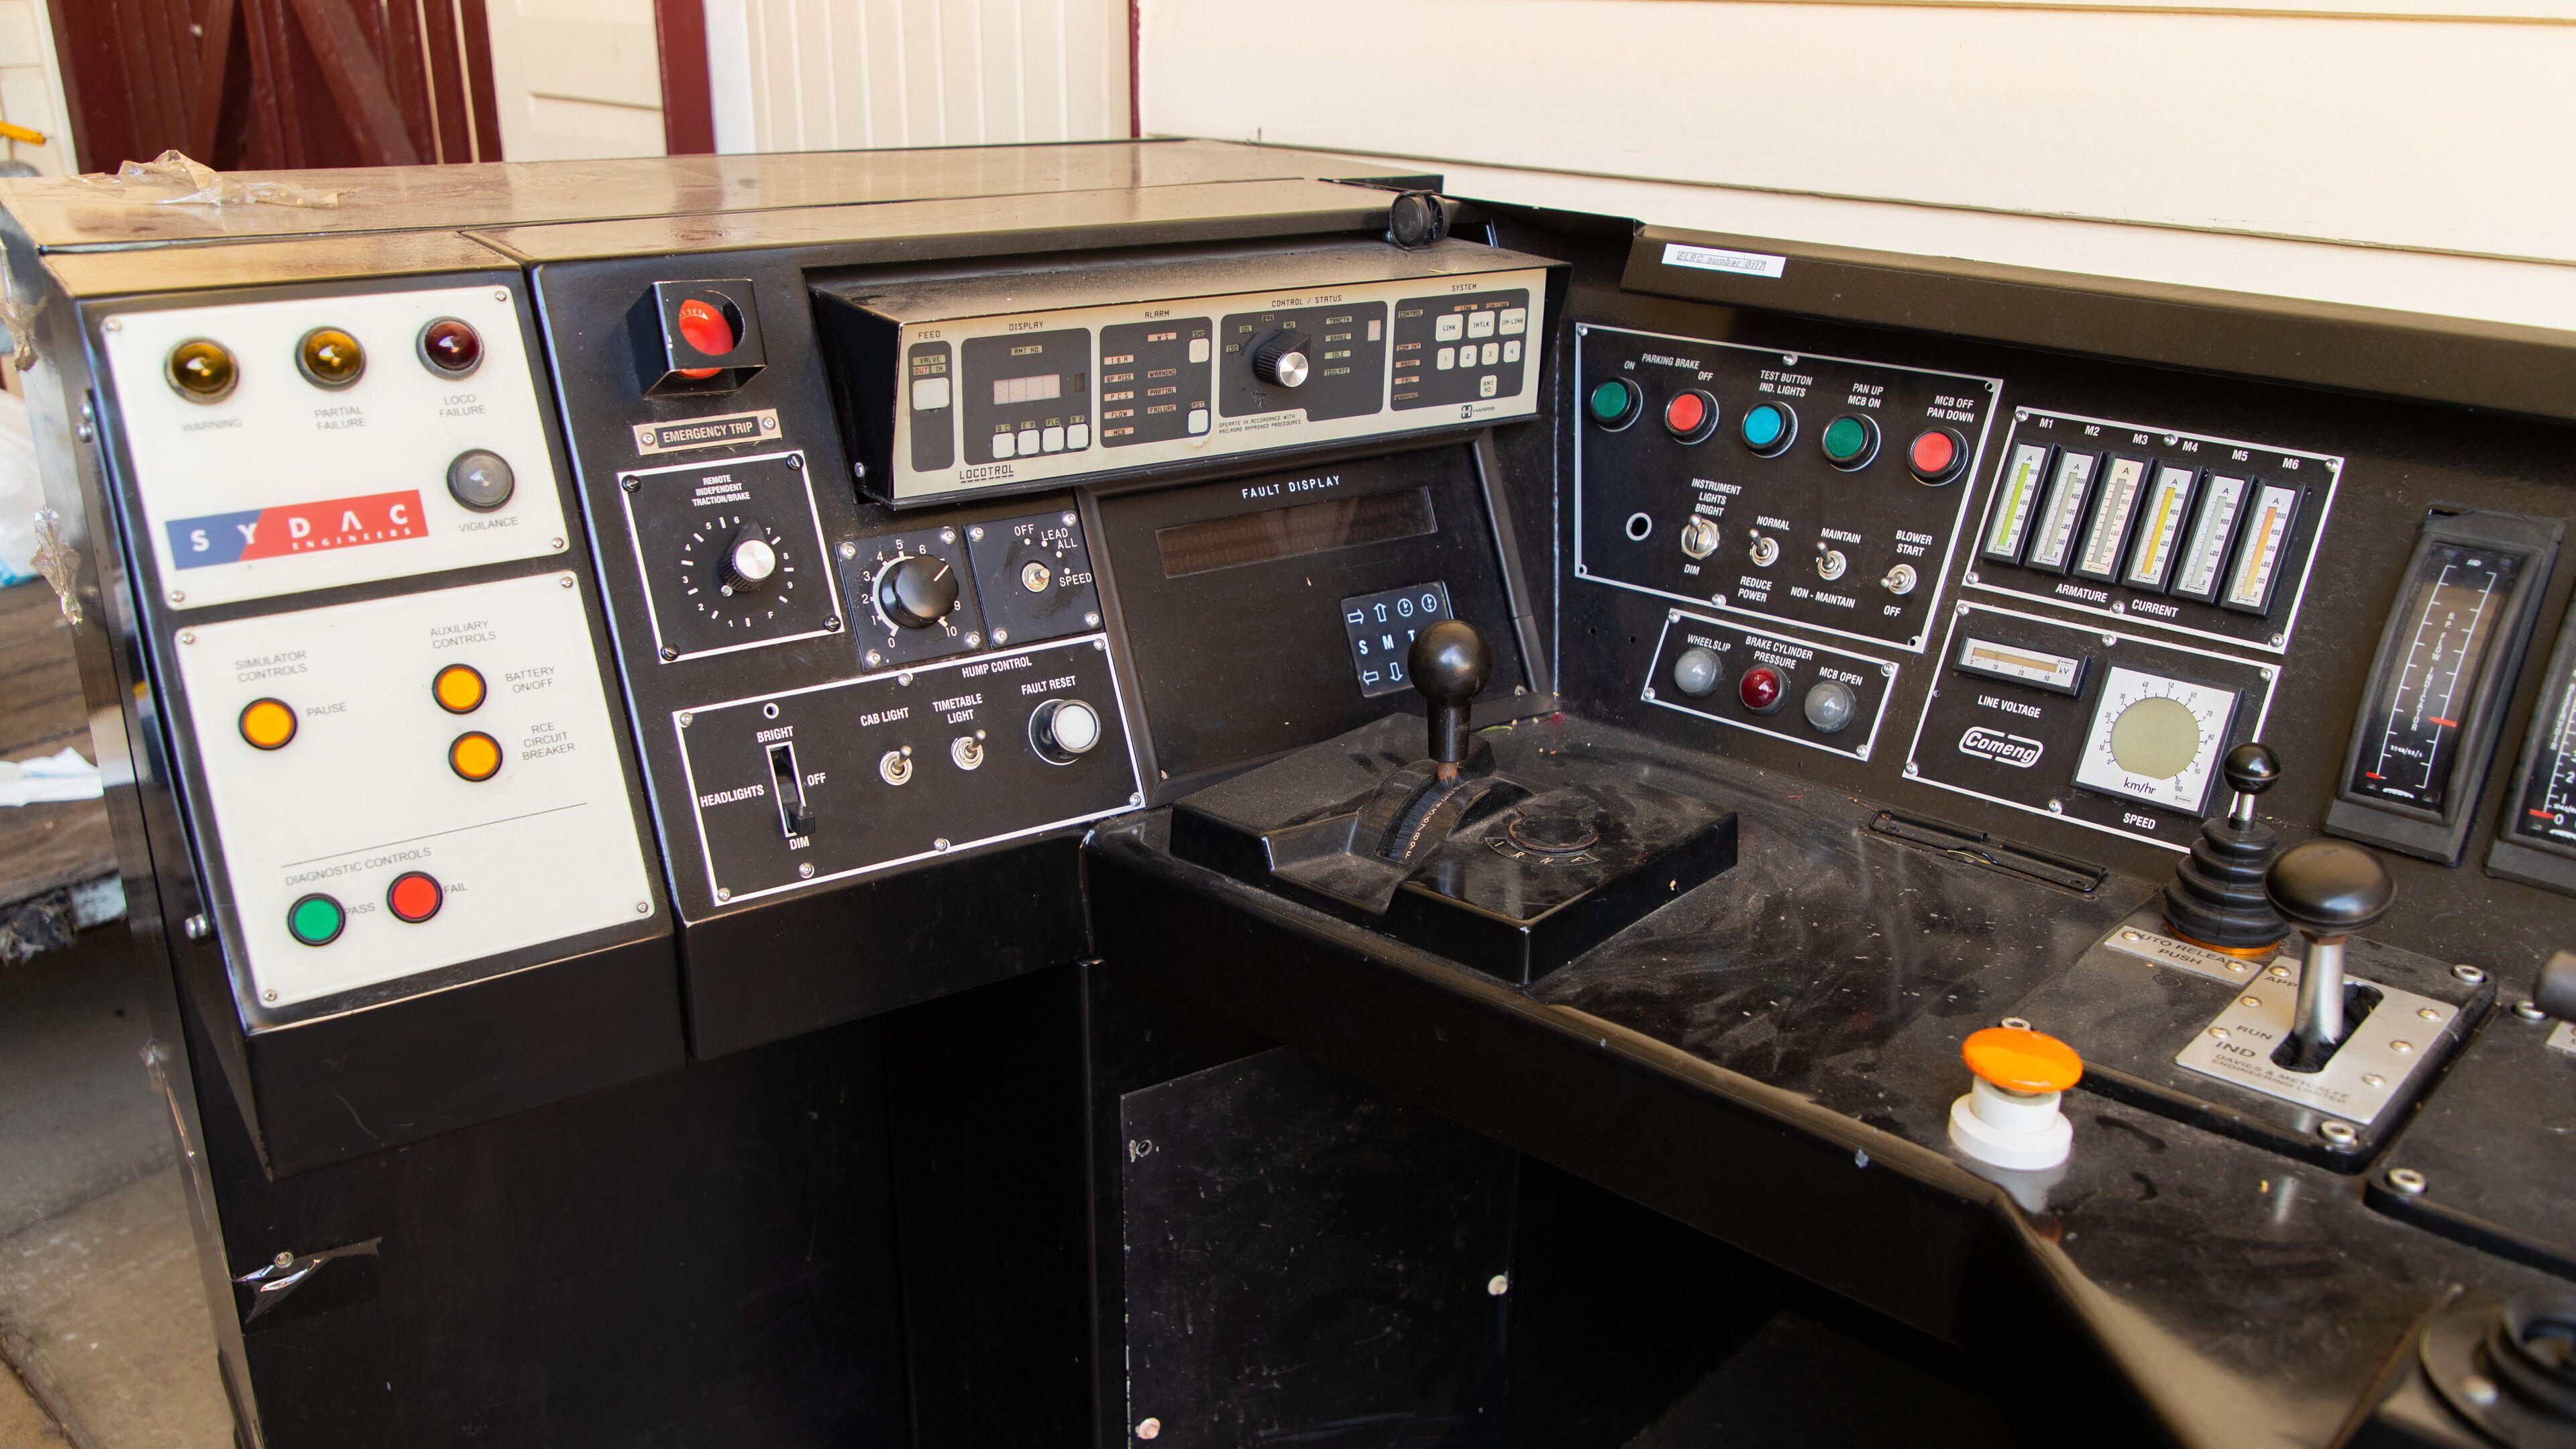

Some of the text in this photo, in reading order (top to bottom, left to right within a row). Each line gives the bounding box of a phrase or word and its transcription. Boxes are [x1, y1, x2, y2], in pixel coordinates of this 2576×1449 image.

[1678, 252, 1766, 270] ELRC number 0117
[1452, 283, 1477, 292] SYSTEM
[1272, 294, 1342, 307] CONTROL STATUS
[1144, 311, 1169, 319] ALARM
[1502, 317, 1523, 325] UN-LINK
[1009, 321, 1043, 331] DISPLAY
[918, 330, 941, 339] FEED
[1624, 360, 1635, 370] ON
[1642, 354, 1700, 370] PARKING BRAKE
[1698, 372, 1713, 382] OFF
[1760, 370, 1813, 386] TEST BUTTON
[1759, 383, 1806, 397] IND. LIGHTS
[1852, 383, 1884, 395] PAN UP
[444, 394, 476, 405] LOCO
[1847, 395, 1881, 408] MCB ON
[1935, 396, 1974, 409] MCB OFF
[315, 406, 364, 419] PARTIAL
[439, 404, 486, 418] FAILURE
[1927, 407, 1974, 423] PAN DOWN
[181, 417, 242, 433] WARNING
[317, 417, 366, 430] FAILURE
[2039, 418, 2053, 429] M1
[2084, 425, 2100, 436] M2
[663, 422, 753, 443] EMERGENCY TRIP
[2133, 433, 2148, 445] M3
[2182, 441, 2198, 452] M4
[2232, 449, 2249, 461] M5
[2282, 458, 2299, 470] M6
[959, 464, 1014, 480] LOCOTROL
[702, 474, 731, 485] REMOTE
[1242, 475, 1339, 498] FAULT DISPLAY
[1691, 478, 1742, 495] INSTRUMENT
[696, 483, 742, 496] INDEPENDENT
[692, 492, 751, 506] TRACTION/BRAKE
[1699, 492, 1727, 505] LIGHTS
[1695, 503, 1724, 517] BRIGHT
[458, 517, 518, 532] VIGILANCE
[1756, 515, 1790, 530] NORMAL
[1014, 524, 1034, 536] OFF
[1041, 528, 1068, 541] LEAD
[1821, 528, 1861, 543] MAINTAIN
[292, 528, 410, 550] ENGINEERS
[896, 539, 904, 549] 5
[1058, 538, 1077, 549] ALL
[1896, 530, 1932, 545] BLOWER
[876, 551, 884, 561] 4
[919, 545, 926, 554] 6
[1896, 543, 1925, 557] START
[863, 571, 870, 581] 3
[1684, 564, 1700, 575] DIM
[1059, 572, 1092, 587] SPEED
[1740, 576, 1772, 590] REDUCE
[861, 594, 869, 604] 2
[1738, 588, 1767, 602] POWER
[1790, 586, 1856, 608] NON MAINTAIN
[2055, 584, 2108, 602] ARMATURE
[953, 600, 961, 610] 9
[1884, 605, 1901, 616] OFF
[2132, 599, 2179, 617] CURRENT
[430, 620, 488, 637] AUXILIARY
[945, 626, 957, 637] 10
[432, 631, 496, 649] CONTROLS
[888, 637, 895, 648] 0
[1383, 635, 1394, 649] M
[1688, 634, 1731, 652] WHEELSLIP
[1358, 641, 1368, 655] S
[1746, 635, 1813, 660] BRAKE CYLINDER
[235, 651, 307, 673] SIMULATOR
[962, 656, 1032, 678] HUMP CONTROL
[1754, 651, 1796, 669] PRESSURE
[237, 663, 307, 682] CONTROLS
[506, 666, 555, 683] BATTERY
[1819, 667, 1863, 686] MCB OPEN
[513, 678, 553, 693] ON/OFF
[1021, 676, 1076, 695] FAULT RESET
[2411, 632, 2447, 731] FLOW INDICATOR
[306, 702, 347, 717] PAUSE
[932, 693, 983, 712] TIMETABLE
[1978, 695, 2041, 718] LINE VOLTAGE
[861, 707, 910, 727] CAB LIGHT
[947, 709, 973, 724] LIGHT
[531, 722, 555, 734] RCE
[757, 726, 793, 743] BRIGHT
[524, 732, 567, 747] CIRCUIT
[1965, 729, 2040, 764] Comeng
[522, 743, 576, 761] BREAKER
[807, 772, 826, 786] OFF
[2124, 777, 2156, 794] km/hr
[700, 784, 764, 808] HEADLIGHTS
[2123, 812, 2155, 829] SPEED
[789, 836, 810, 850] DIM
[285, 847, 431, 886] DIAGNOSTIC CONTROLS
[443, 882, 468, 895] FAIL
[344, 903, 376, 916] PASS
[2158, 948, 2204, 965] PUSH
[2264, 977, 2298, 986] APP
[2237, 1026, 2272, 1040] RUN
[2216, 1042, 2256, 1057] IND
[2211, 1059, 2294, 1087] ENGINEERING
[2215, 1054, 2351, 1098] DAVIES METCALFE
